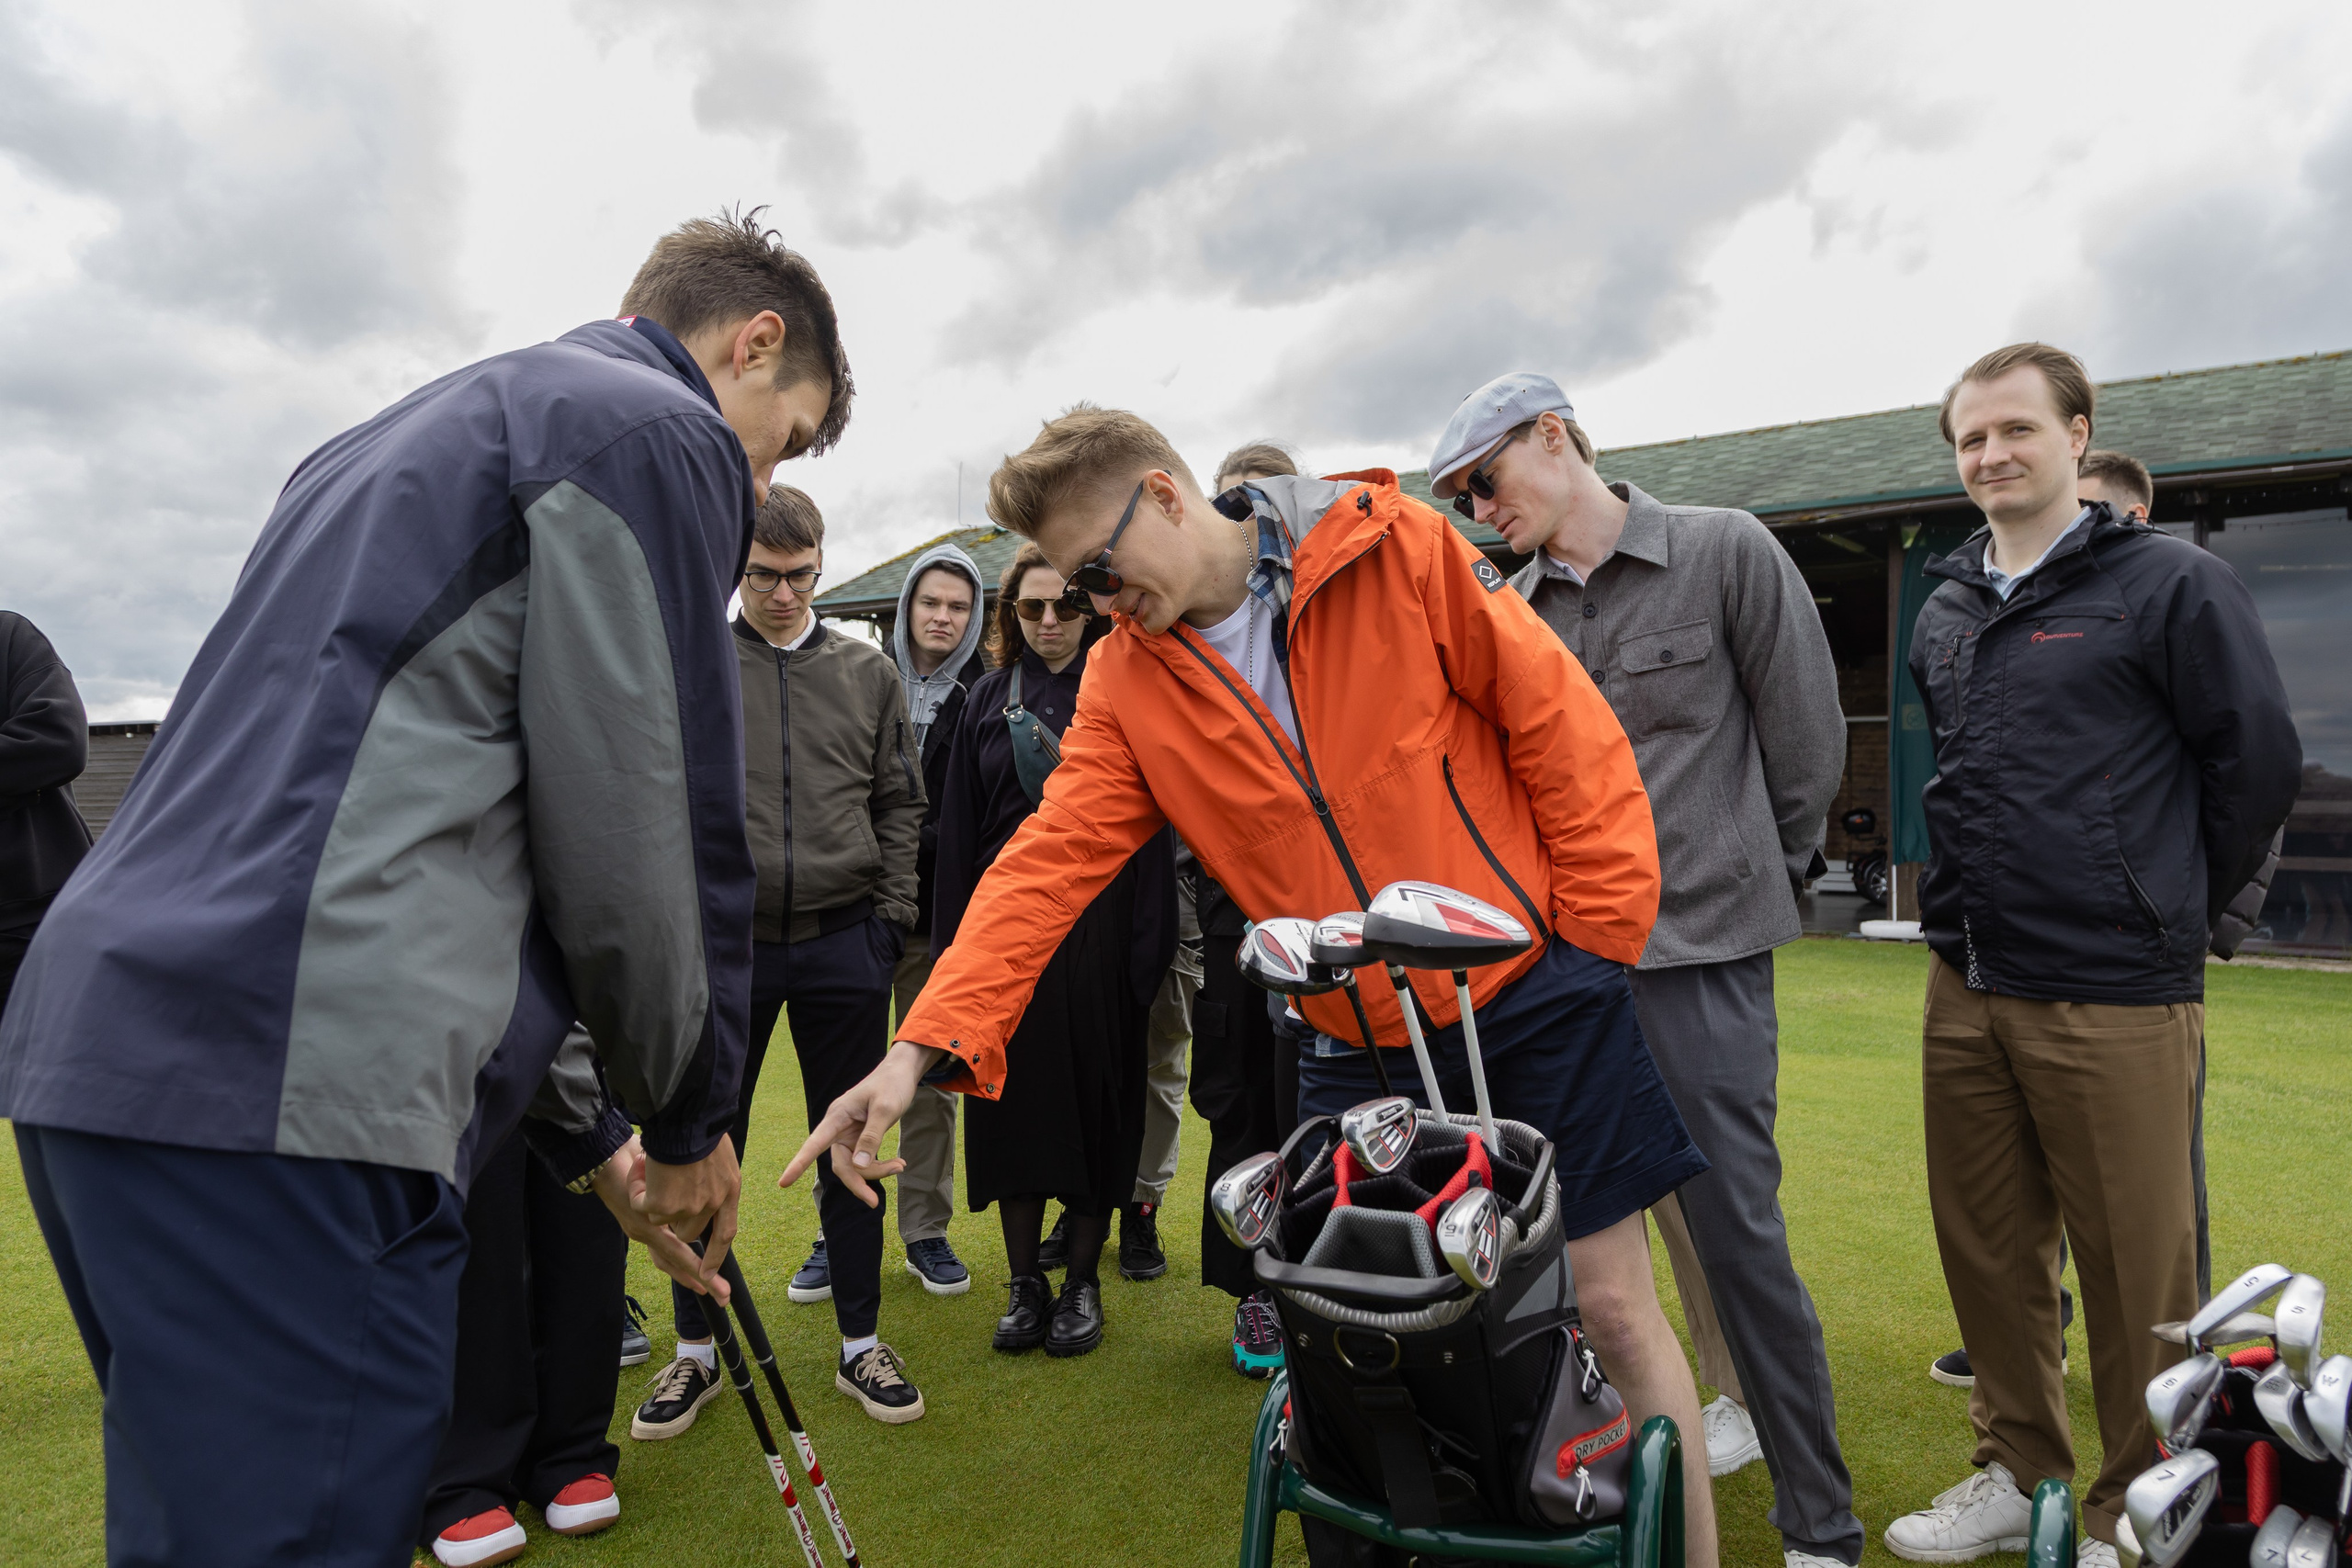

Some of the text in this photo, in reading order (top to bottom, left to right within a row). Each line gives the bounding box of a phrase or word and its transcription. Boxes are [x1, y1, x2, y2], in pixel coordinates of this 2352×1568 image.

[2045, 632, 2084, 640] OUTVENTURE
[1220, 1182, 1231, 1192] 8
[2244, 1276, 2260, 1288] 5
[1576, 1421, 1625, 1458] DRY POCKET
[2156, 1469, 2177, 1481] 7
